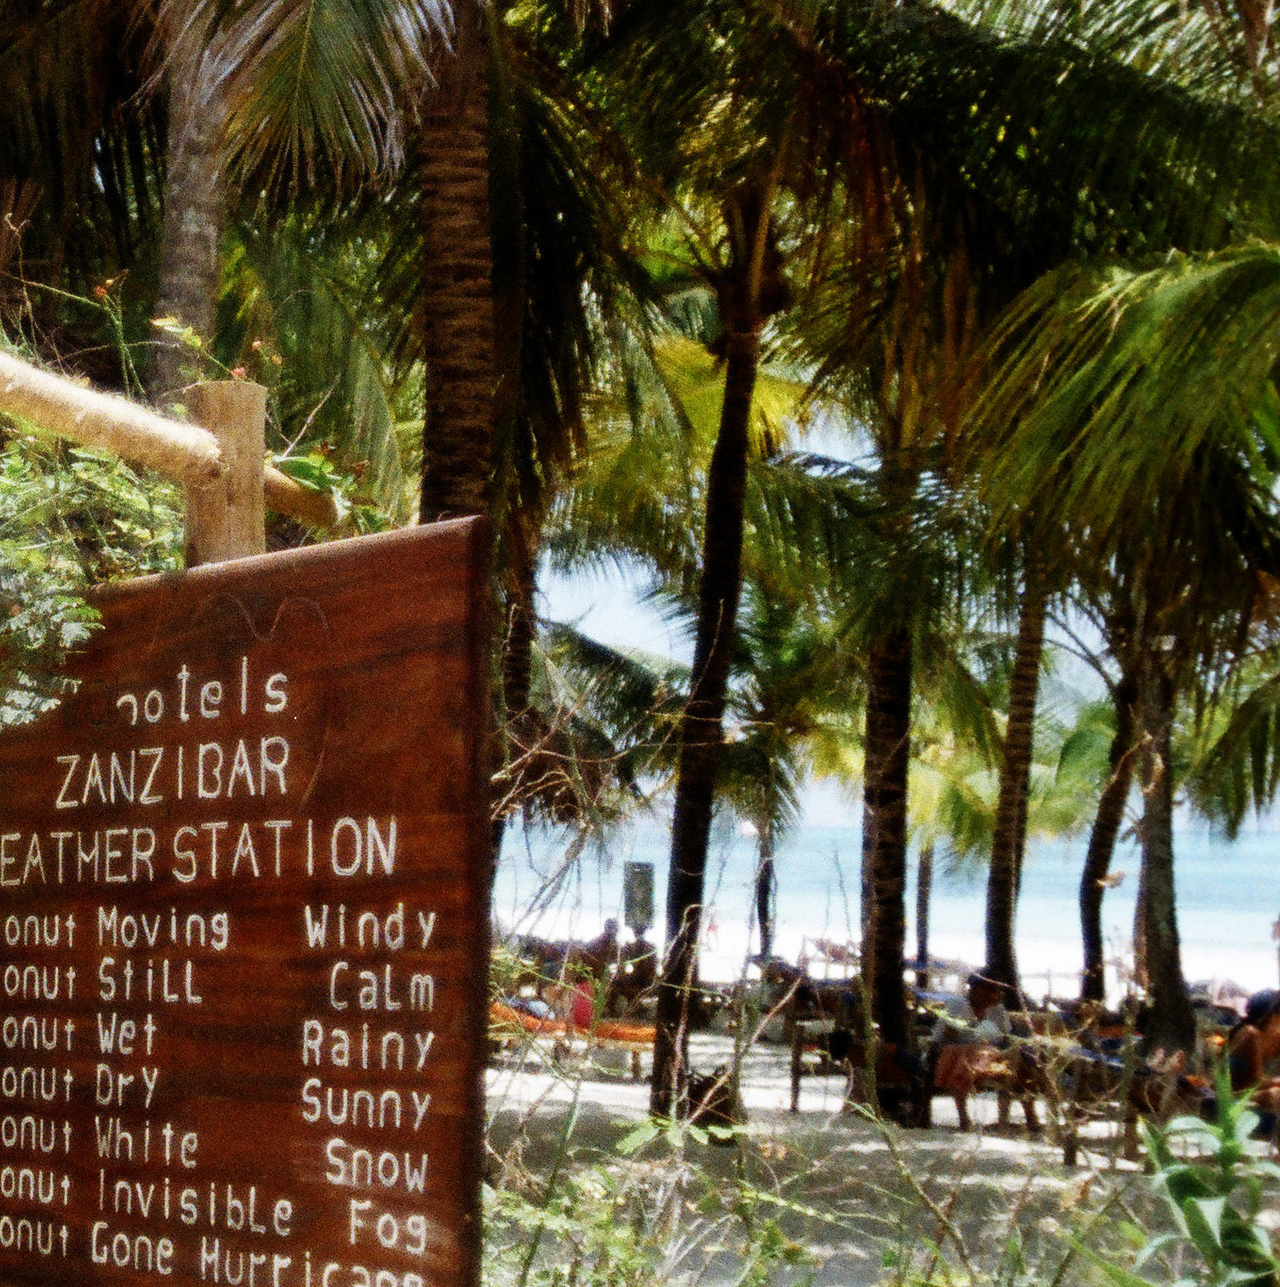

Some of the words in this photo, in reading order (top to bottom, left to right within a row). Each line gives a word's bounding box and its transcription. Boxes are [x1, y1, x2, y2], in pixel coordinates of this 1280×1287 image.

[56, 736, 289, 810] ZANZIBAR
[172, 815, 398, 882] STATION
[97, 905, 230, 950] Moving
[304, 901, 437, 951] Windy
[97, 1012, 157, 1055] Wet
[302, 1019, 437, 1070] Rainy
[95, 1064, 160, 1108] Dry
[301, 1078, 433, 1130] Sunny
[94, 1116, 199, 1169] White
[325, 1137, 429, 1193] Snow
[91, 1220, 175, 1275] Gone
[347, 1199, 428, 1257] Fog
